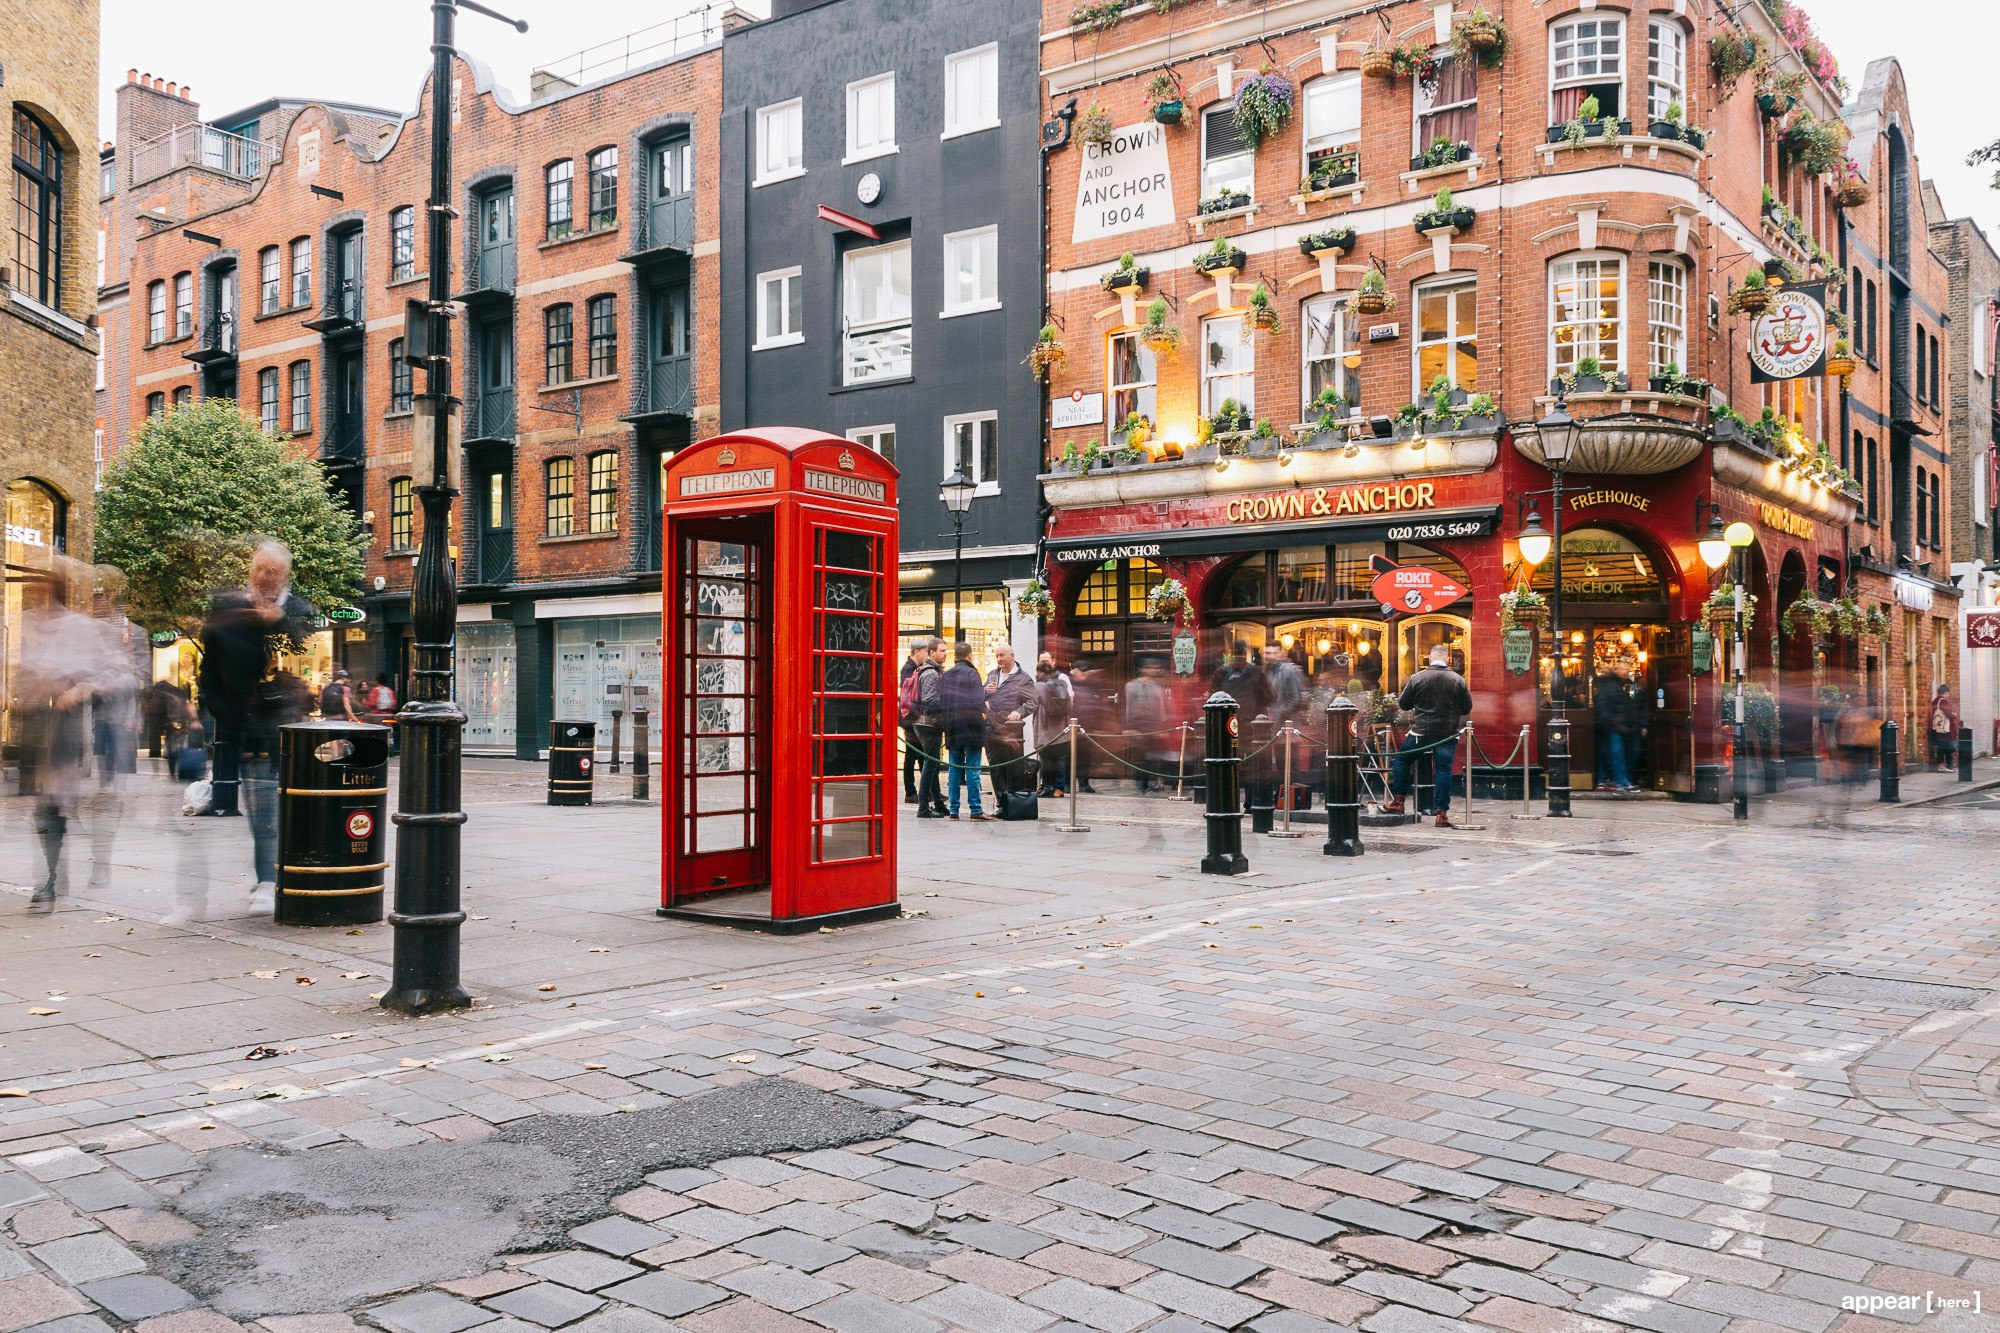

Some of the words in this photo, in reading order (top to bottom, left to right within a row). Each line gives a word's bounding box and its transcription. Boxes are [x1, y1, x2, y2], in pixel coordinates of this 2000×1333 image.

[1087, 126, 1160, 160] CROWN
[1085, 165, 1113, 181] AND
[1082, 173, 1166, 207] ANCHOR
[1102, 203, 1145, 228] 1904
[1781, 293, 1810, 306] OWN
[1754, 353, 1774, 372] AND
[1776, 347, 1821, 376] ANCHOR
[686, 470, 772, 494] TELEPHONE
[807, 471, 883, 500] TELEPHONE
[1226, 494, 1305, 522] CROWN
[1311, 487, 1332, 515] &
[1335, 482, 1435, 515] ANCHOR
[1570, 490, 1651, 512] FREEHOUSE
[1387, 526, 1413, 540] 020
[1414, 524, 1445, 538] 7836
[1448, 522, 1481, 536] 5649
[1057, 548, 1098, 561] CROWN
[1099, 547, 1110, 559] &
[1110, 544, 1161, 558] ANCHOR
[1562, 539, 1621, 552] CROWN
[1583, 558, 1600, 577] &
[1395, 571, 1432, 584] ROKIT
[1561, 582, 1623, 594] ANCHOR
[331, 609, 360, 619] schuh
[596, 696, 618, 705] Virtus
[342, 772, 376, 785] Litter
